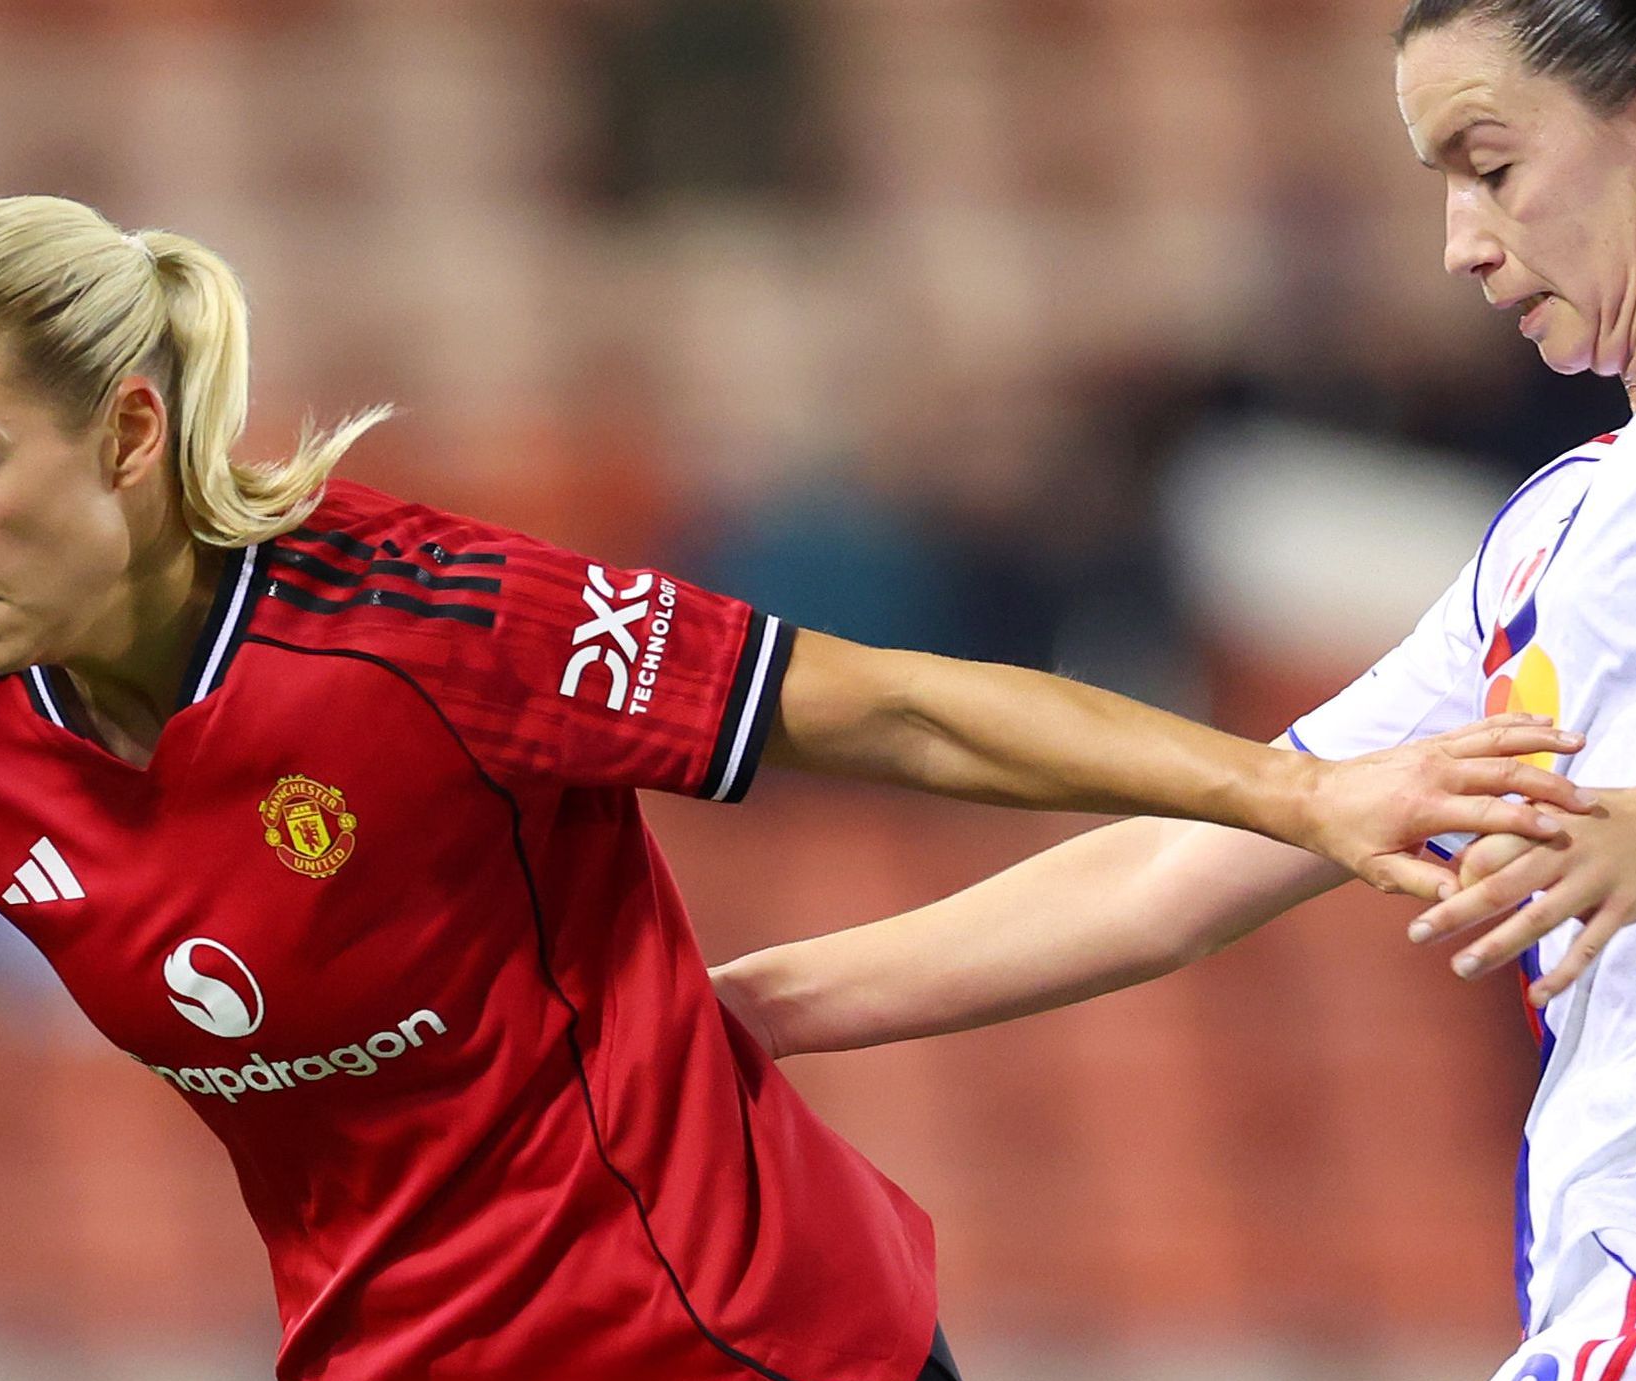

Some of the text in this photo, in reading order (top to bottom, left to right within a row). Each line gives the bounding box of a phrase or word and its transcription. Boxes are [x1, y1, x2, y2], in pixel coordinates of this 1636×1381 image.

[559, 564, 653, 712] DXC
[628, 577, 677, 715] TECHNOLOGY
[267, 783, 338, 820] MANCHESTER
[293, 848, 346, 872] UNITED
[131, 1009, 448, 1104] napdragon
